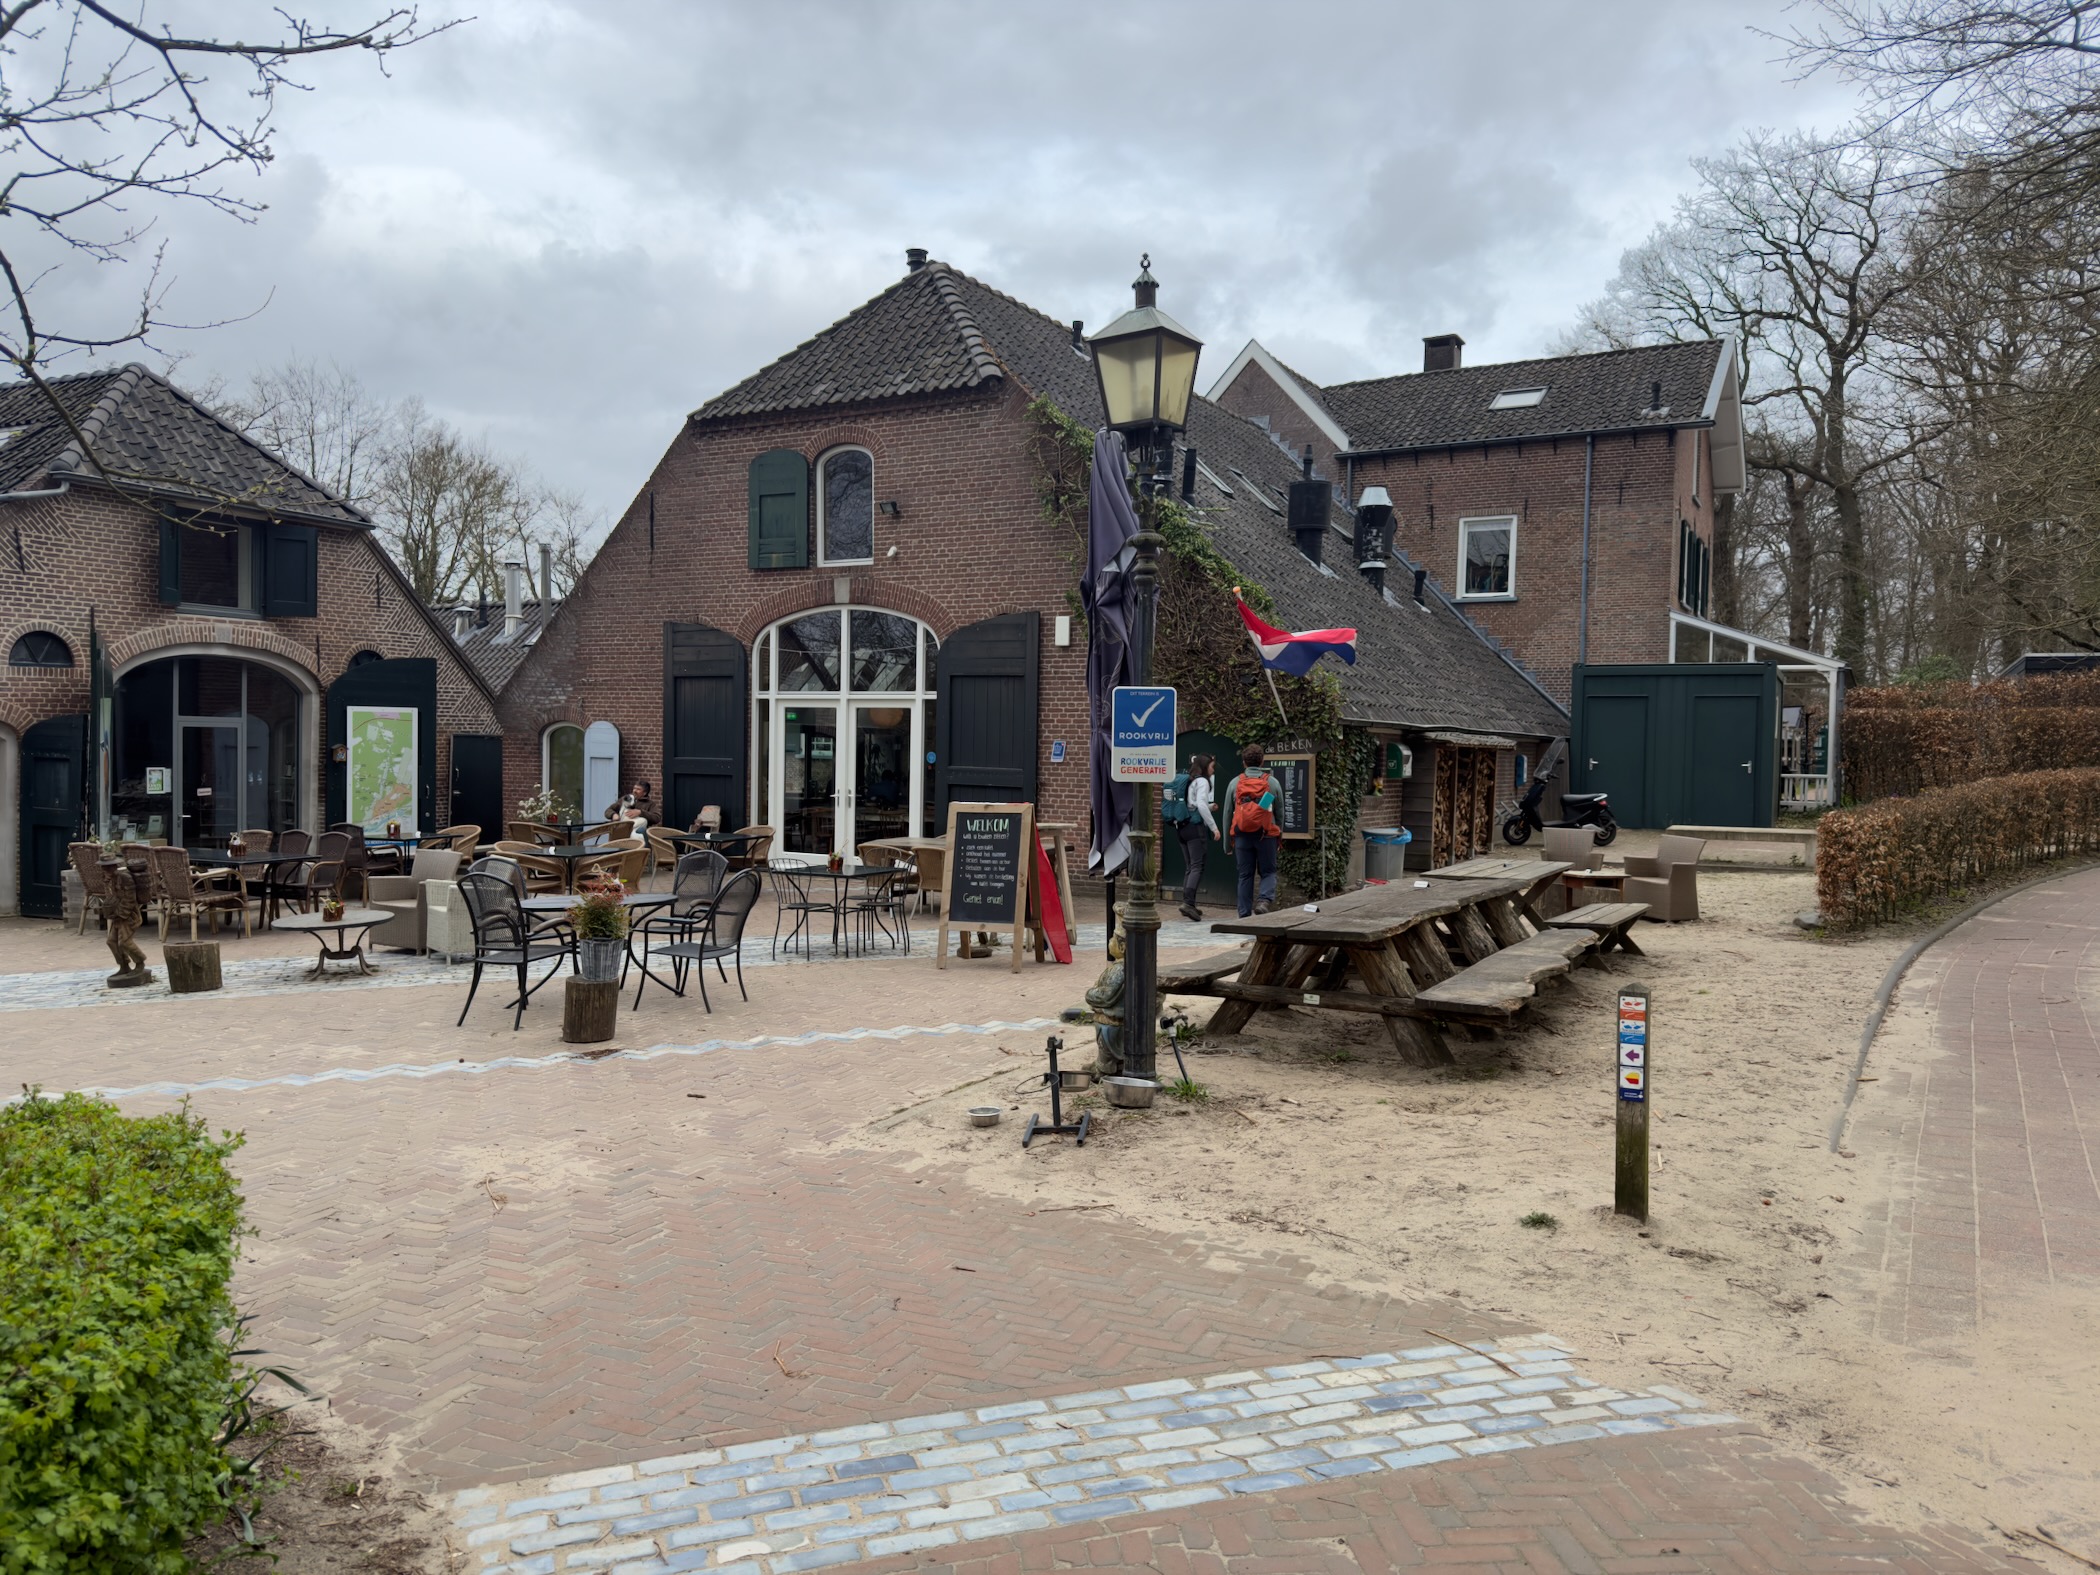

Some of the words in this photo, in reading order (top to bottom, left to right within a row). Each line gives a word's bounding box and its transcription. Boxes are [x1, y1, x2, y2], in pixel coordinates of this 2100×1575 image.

[1119, 732, 1170, 740] ROOKVRIJ
[1277, 739, 1312, 752] BEKEN
[966, 818, 1009, 832] WELKOM
[963, 893, 982, 904] Geniet
